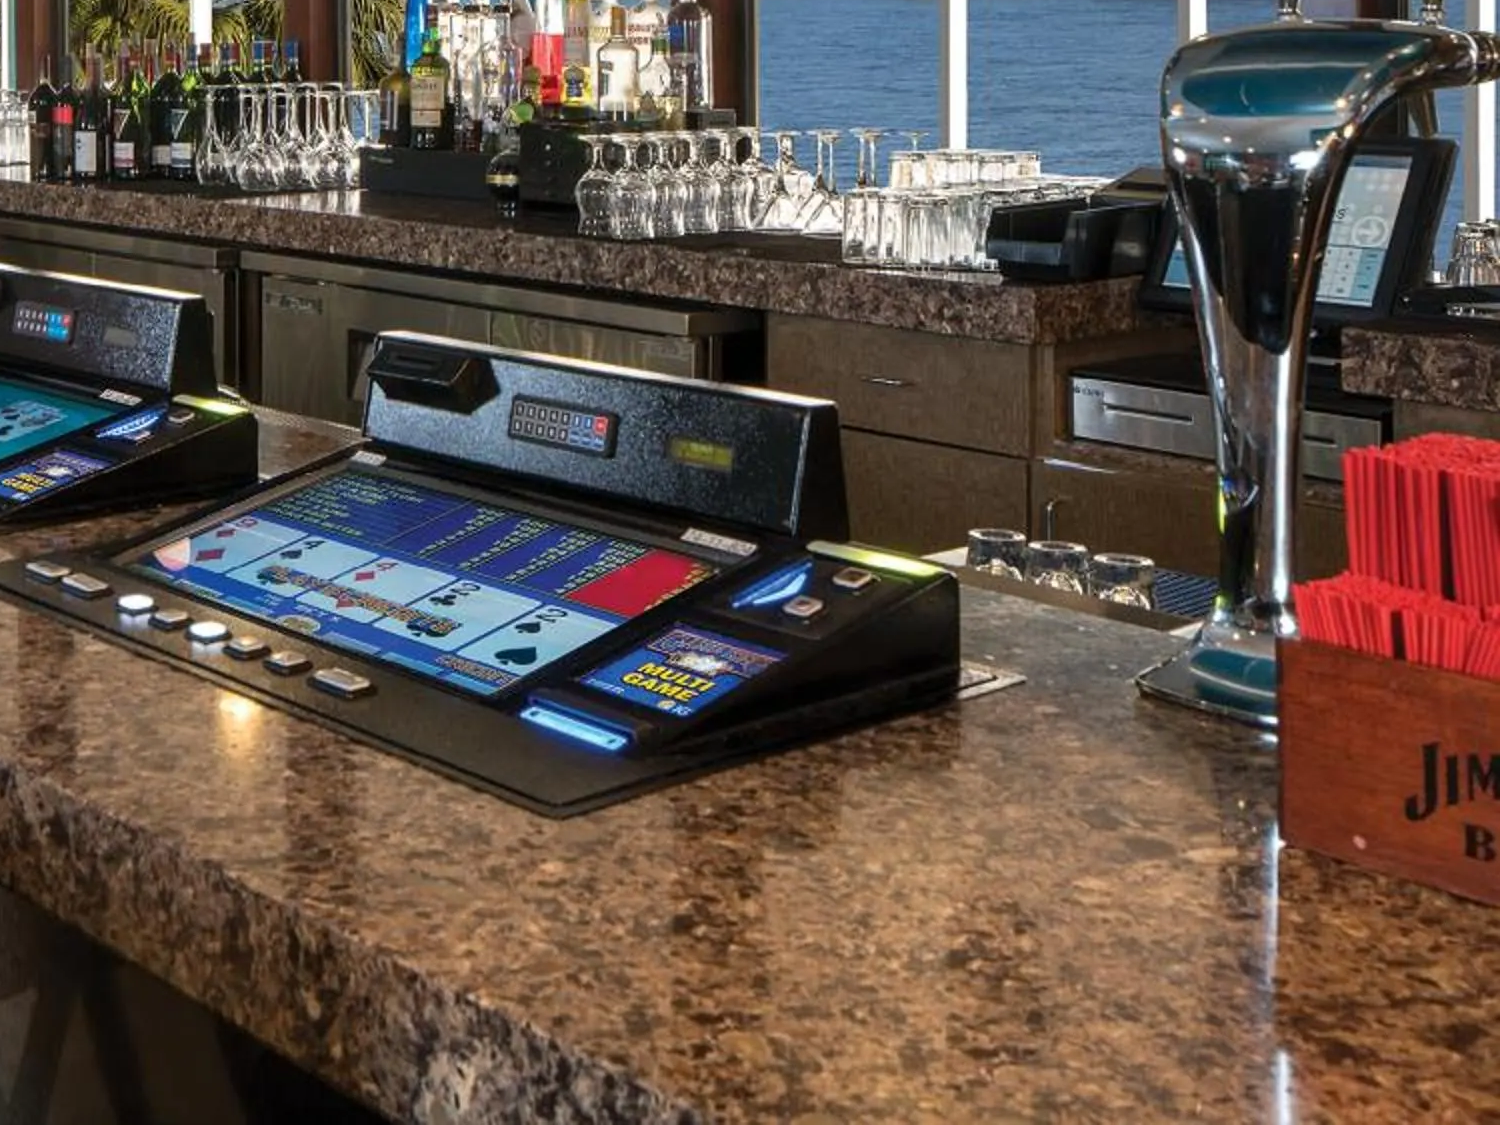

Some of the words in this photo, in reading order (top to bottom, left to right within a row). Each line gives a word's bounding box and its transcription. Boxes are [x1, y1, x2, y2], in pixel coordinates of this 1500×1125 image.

[302, 540, 326, 550] 4
[375, 561, 399, 572] 4
[450, 582, 481, 596] 2
[534, 608, 568, 623] 2
[636, 662, 716, 692] MULTI
[621, 672, 700, 702] GAME
[1404, 741, 1500, 822] JIM
